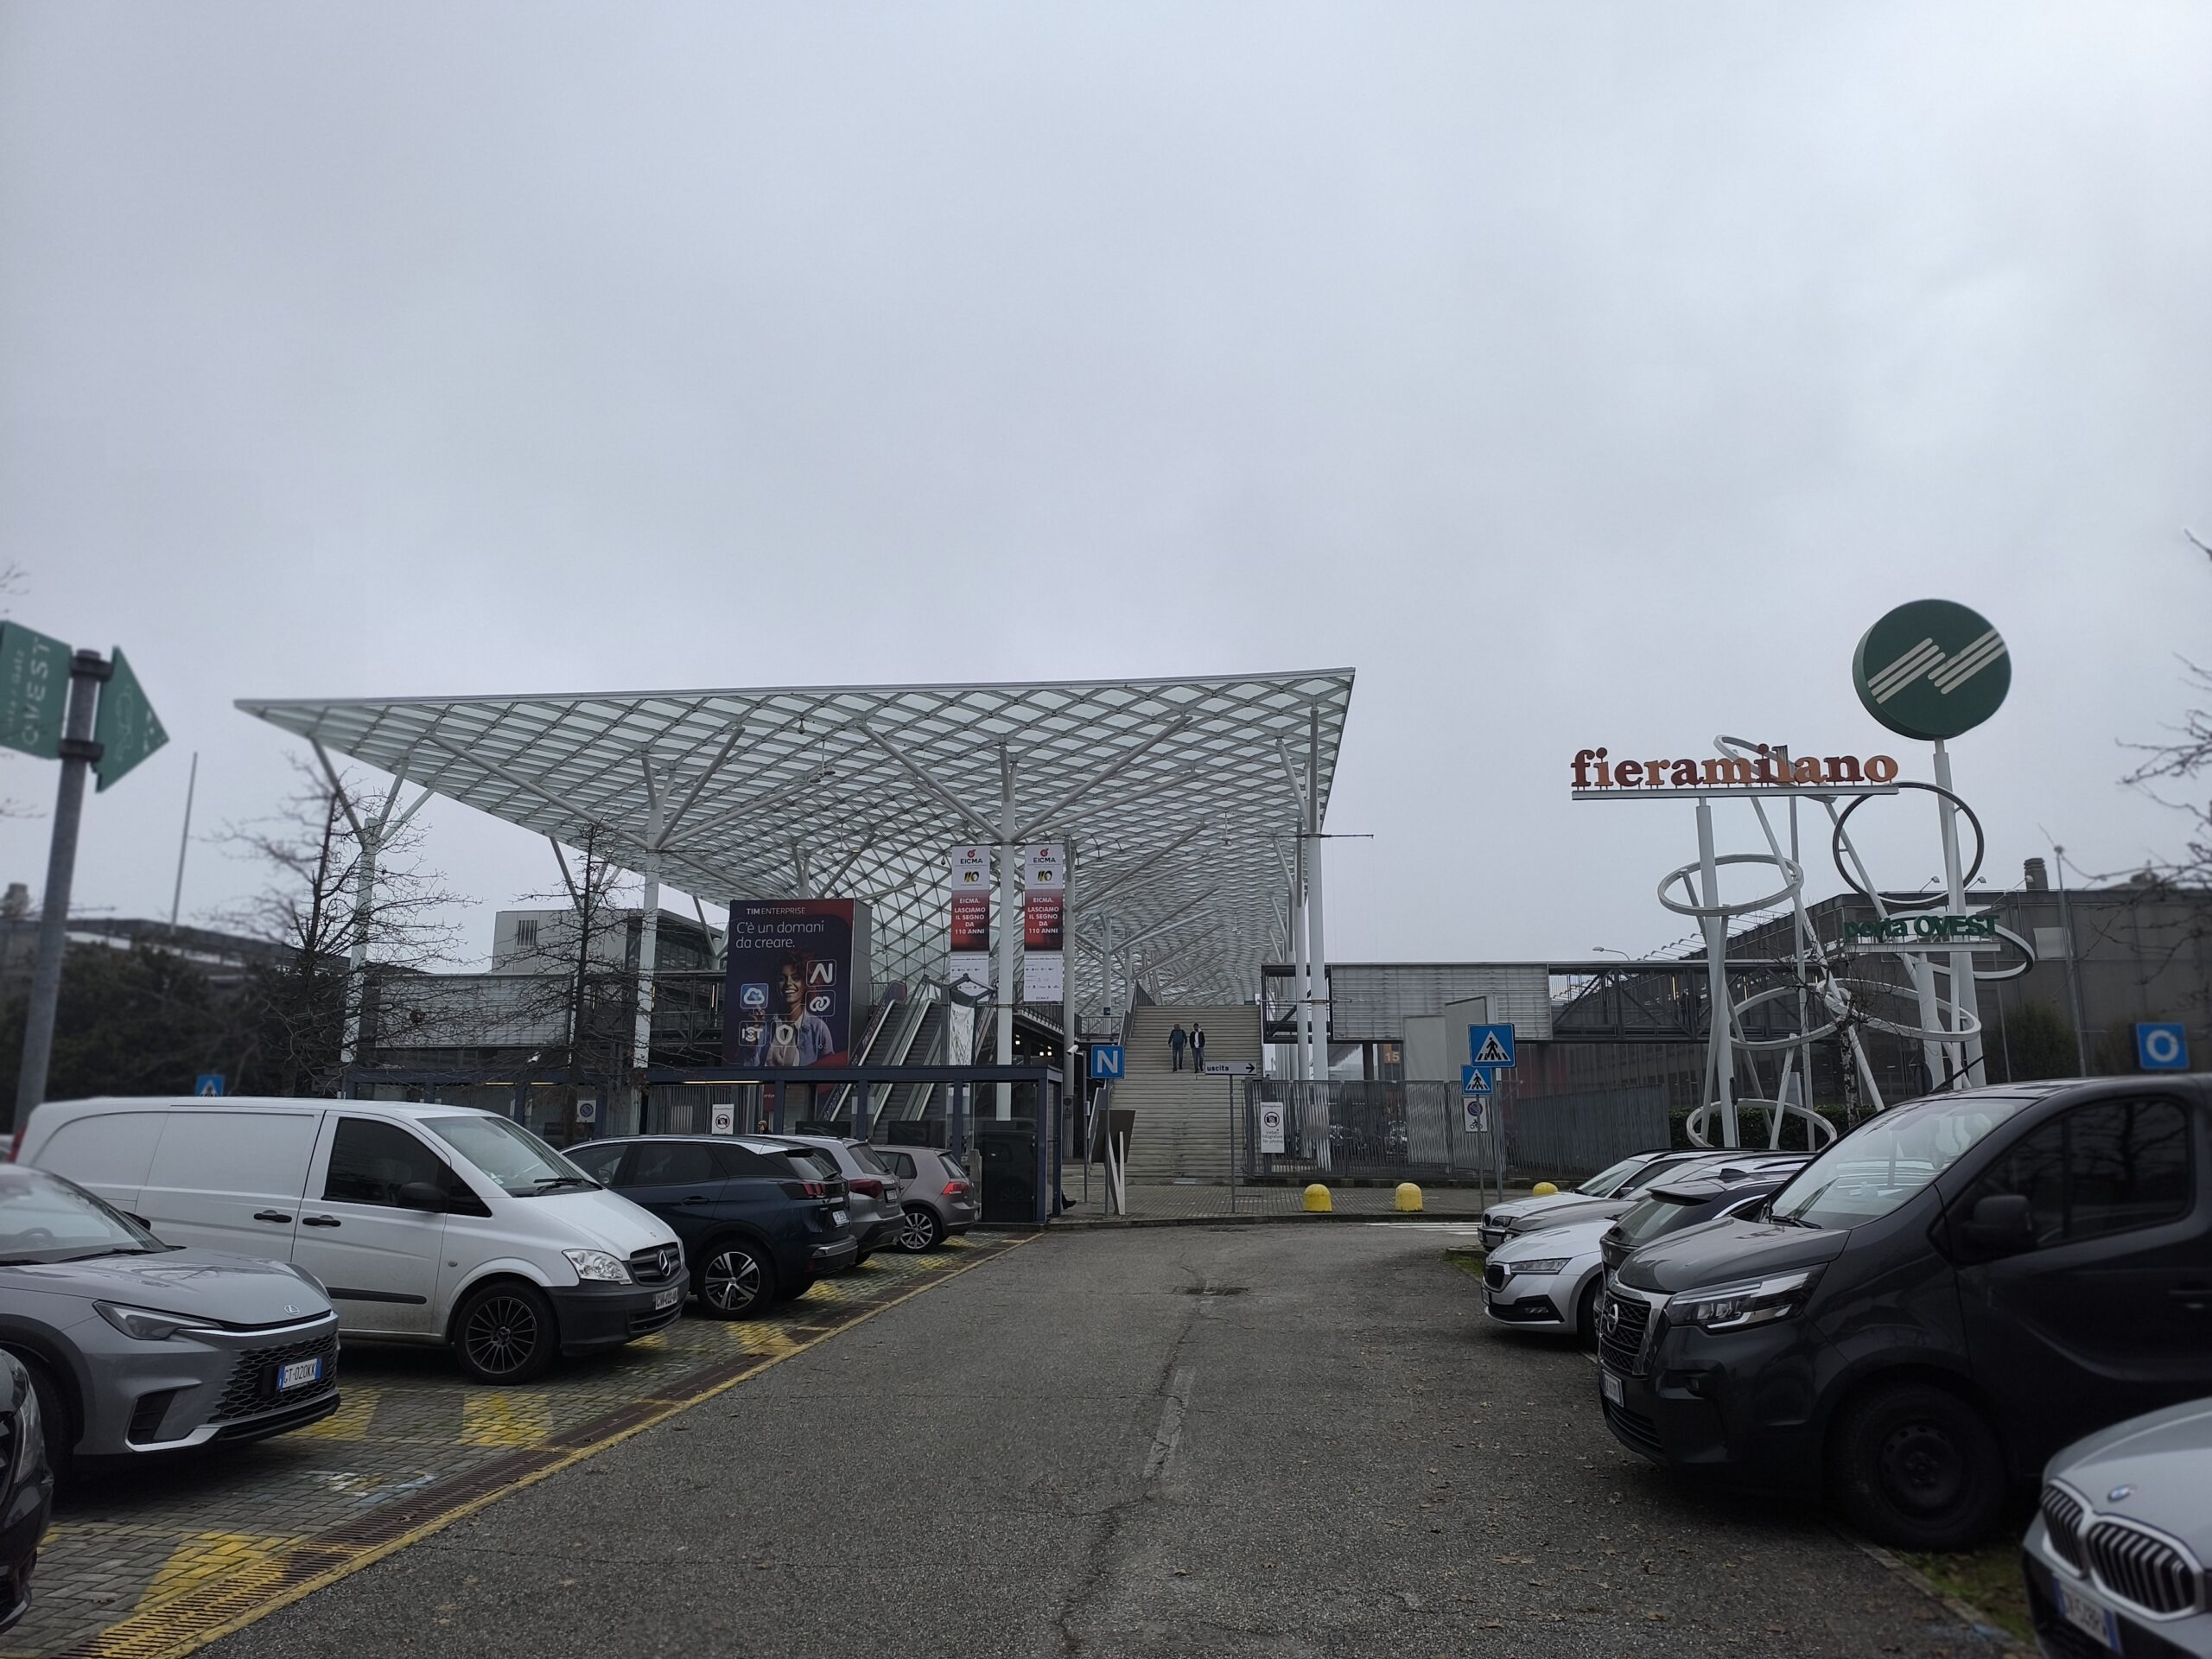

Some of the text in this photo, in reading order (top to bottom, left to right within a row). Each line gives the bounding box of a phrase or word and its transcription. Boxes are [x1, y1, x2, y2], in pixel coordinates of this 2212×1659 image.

[22, 636, 50, 746] OVEST
[1570, 743, 1898, 787] fieramilano
[758, 923, 773, 933] un
[777, 920, 824, 933] domani
[1843, 915, 2000, 942] porta OVEST
[736, 937, 795, 948] da creare.
[1385, 1052, 1400, 1062] 15
[2145, 1029, 2179, 1063] O
[1096, 1050, 1118, 1073] N
